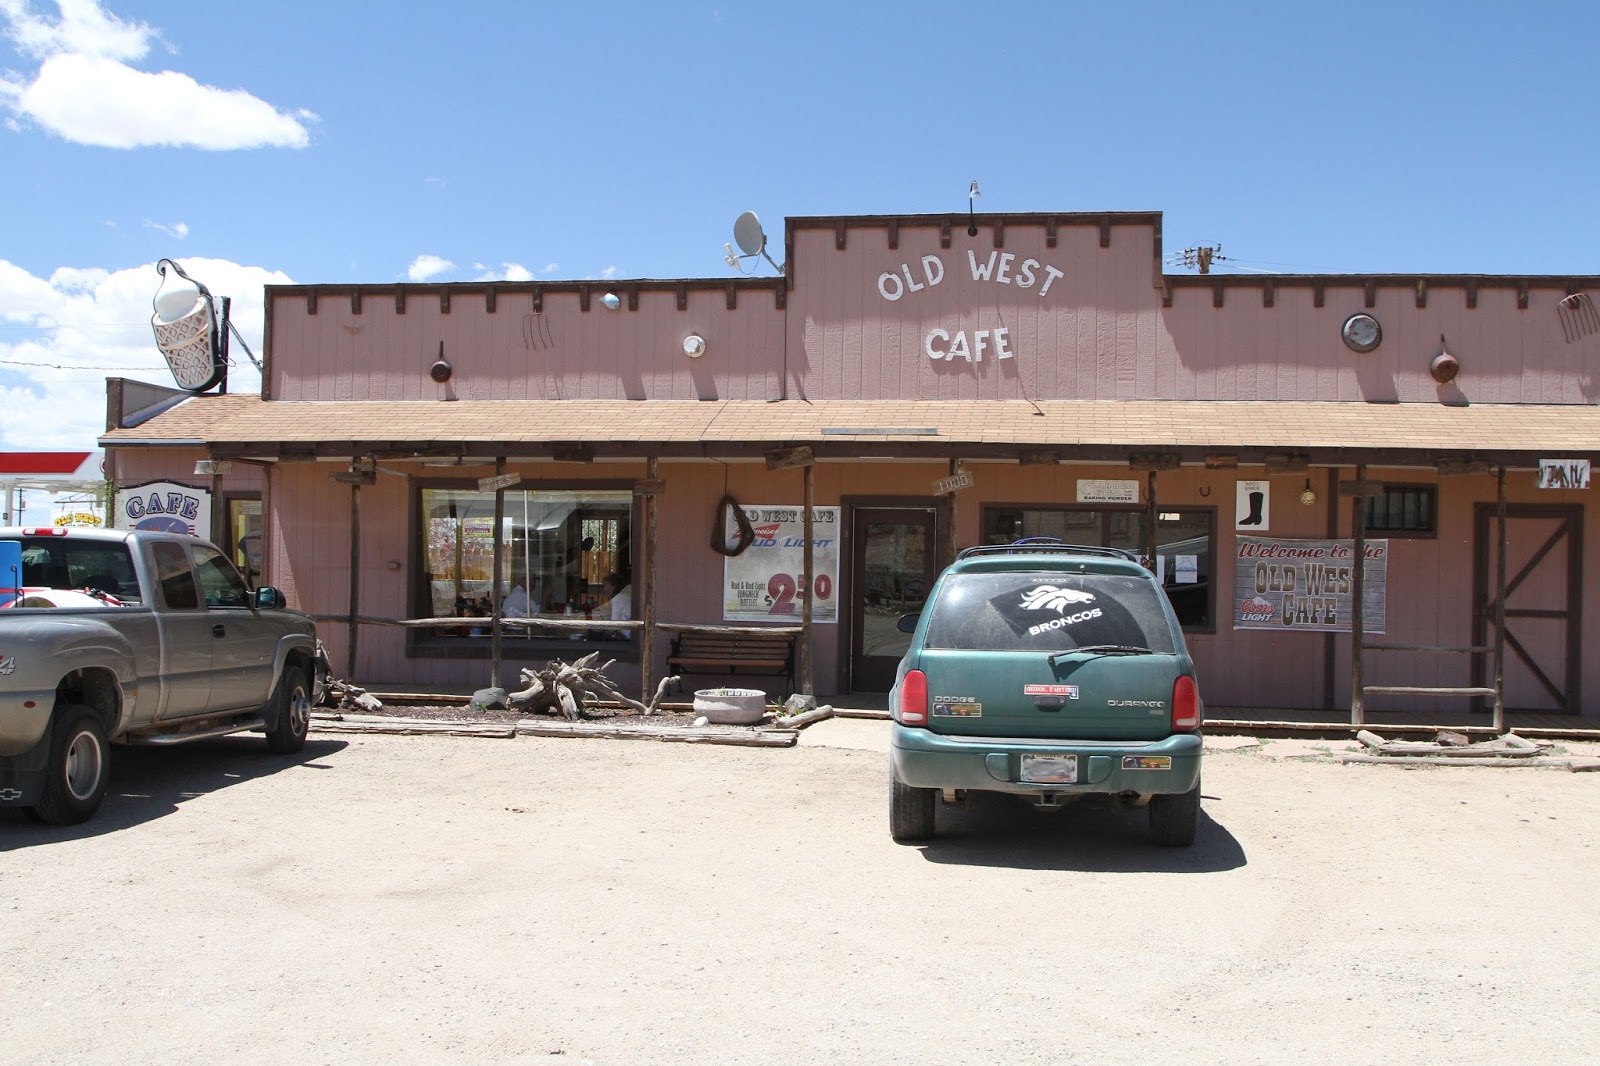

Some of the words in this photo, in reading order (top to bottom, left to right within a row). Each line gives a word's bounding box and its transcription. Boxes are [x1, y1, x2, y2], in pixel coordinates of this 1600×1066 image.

[878, 255, 944, 301] OLD
[967, 250, 1064, 297] WEST
[925, 328, 1013, 363] CAFE
[126, 492, 200, 520] CAFE
[762, 510, 798, 523] WEST
[751, 539, 777, 548] UD
[1238, 543, 1324, 558] Welcome
[1330, 544, 1349, 558] to
[1363, 544, 1384, 558] he
[1255, 561, 1297, 595] OLD
[1241, 599, 1275, 614] Coors
[1281, 593, 1338, 627] CAFE
[1028, 607, 1103, 636] BRONCOS
[1241, 613, 1273, 622] LIGHT
[934, 695, 976, 703] DODGE
[1107, 699, 1166, 708] DURANGO
